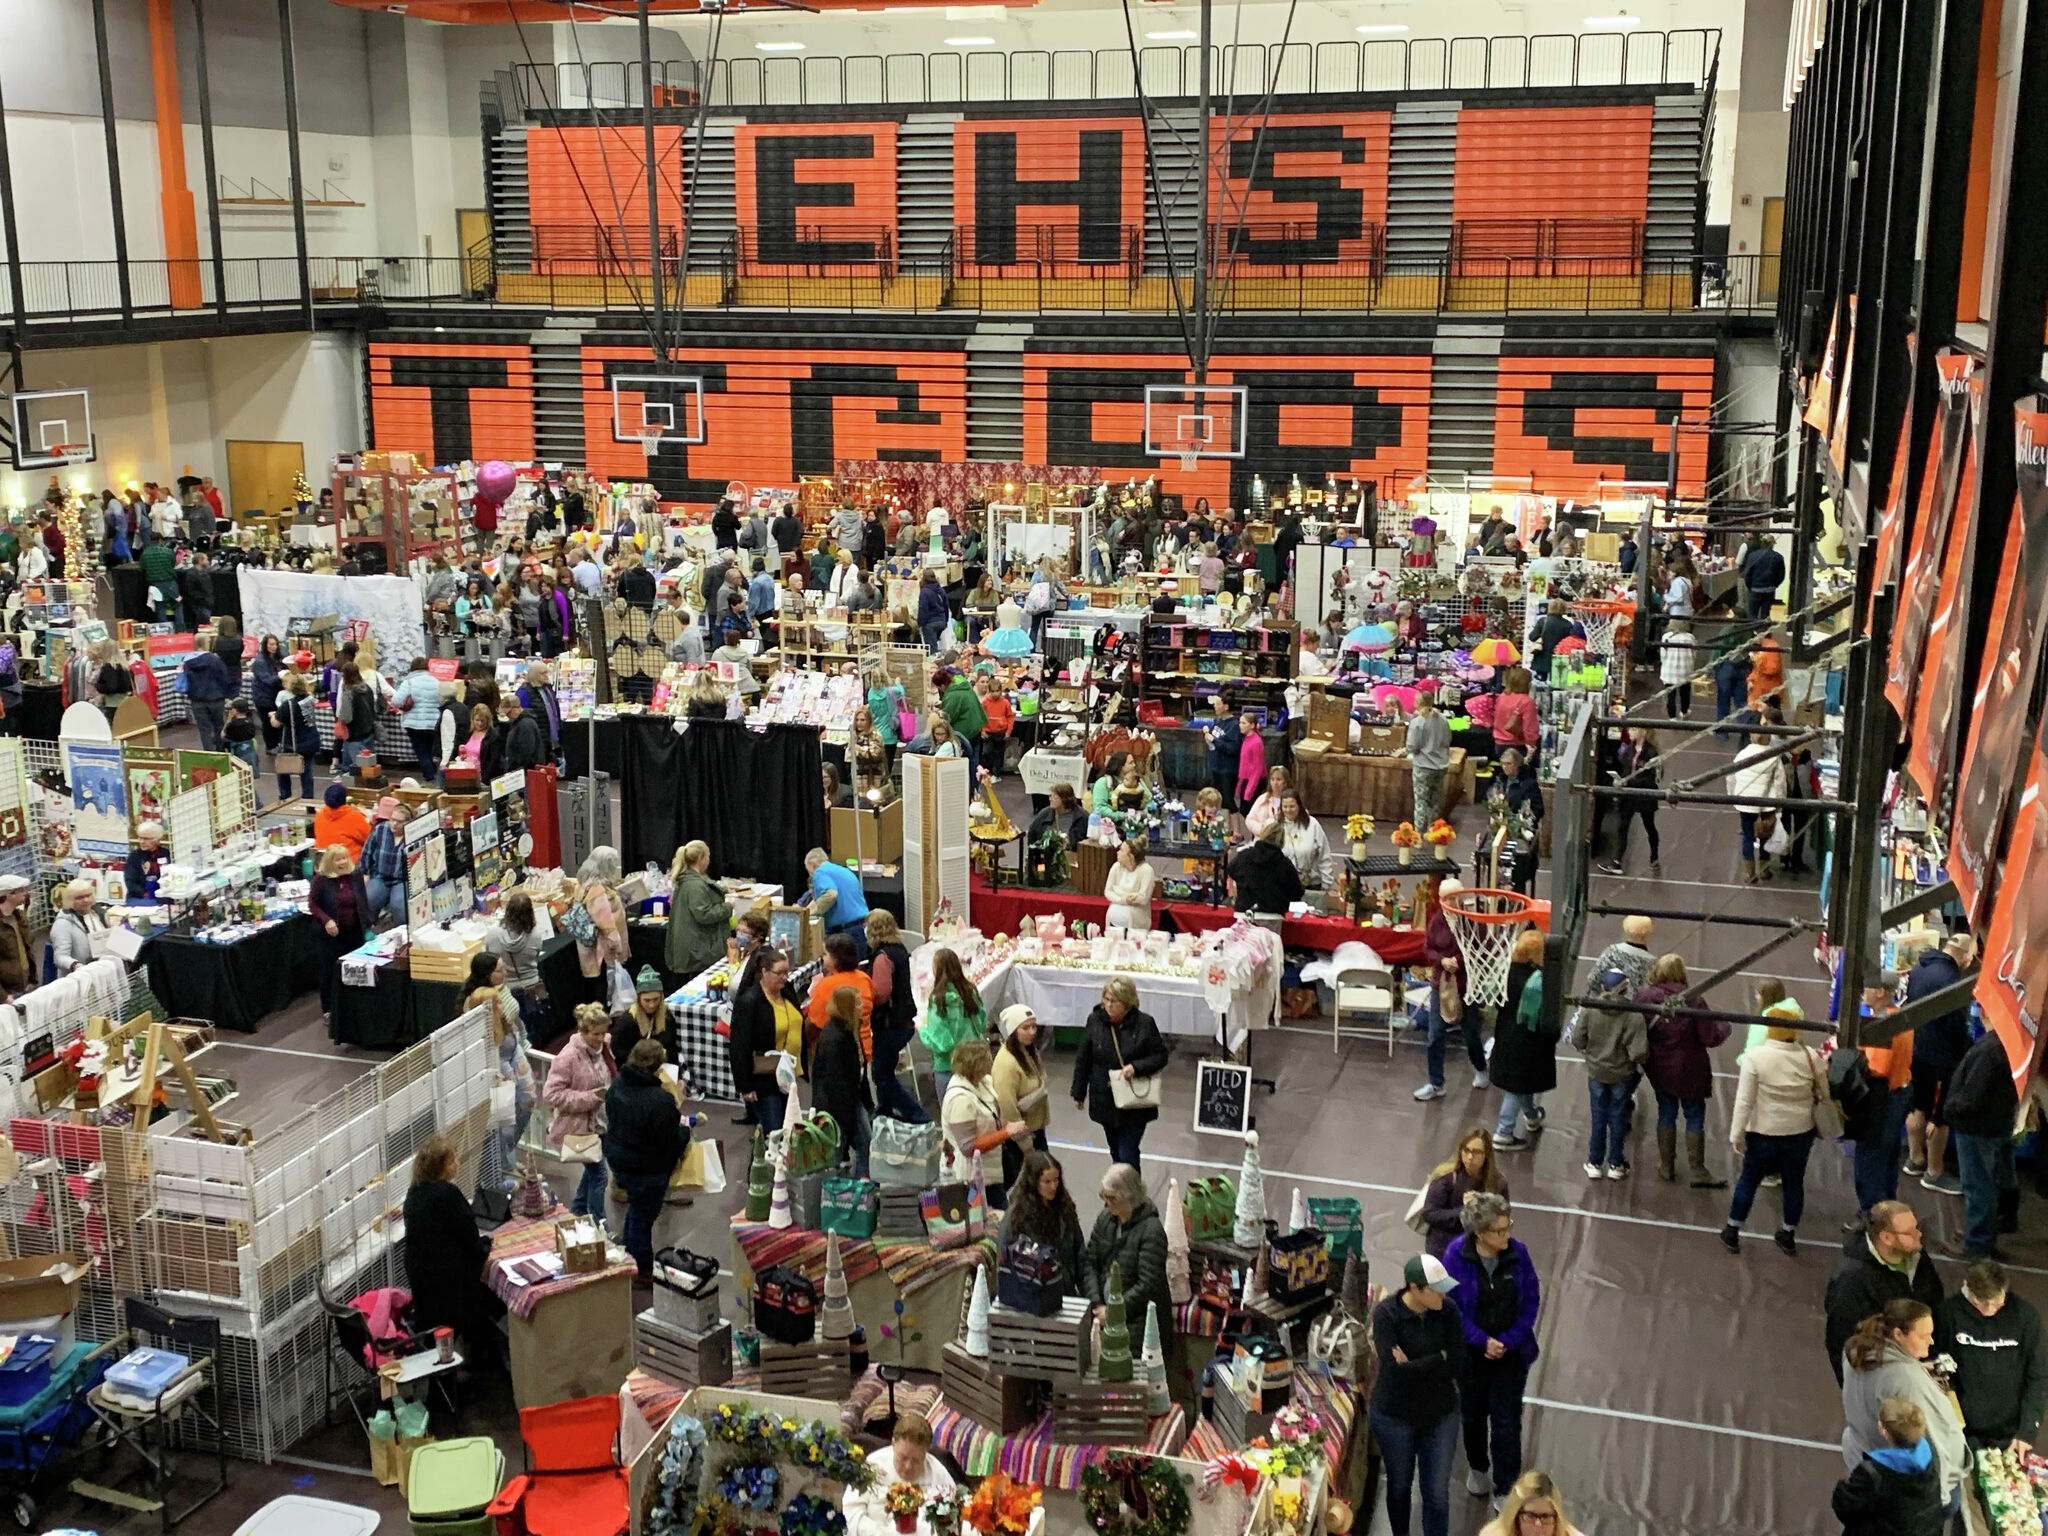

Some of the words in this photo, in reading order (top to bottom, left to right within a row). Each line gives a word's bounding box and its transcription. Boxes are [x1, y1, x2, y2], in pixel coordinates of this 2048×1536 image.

[755, 125, 1366, 266] EHS
[1204, 1069, 1242, 1089] TIED
[1203, 1101, 1239, 1117] TOTS
